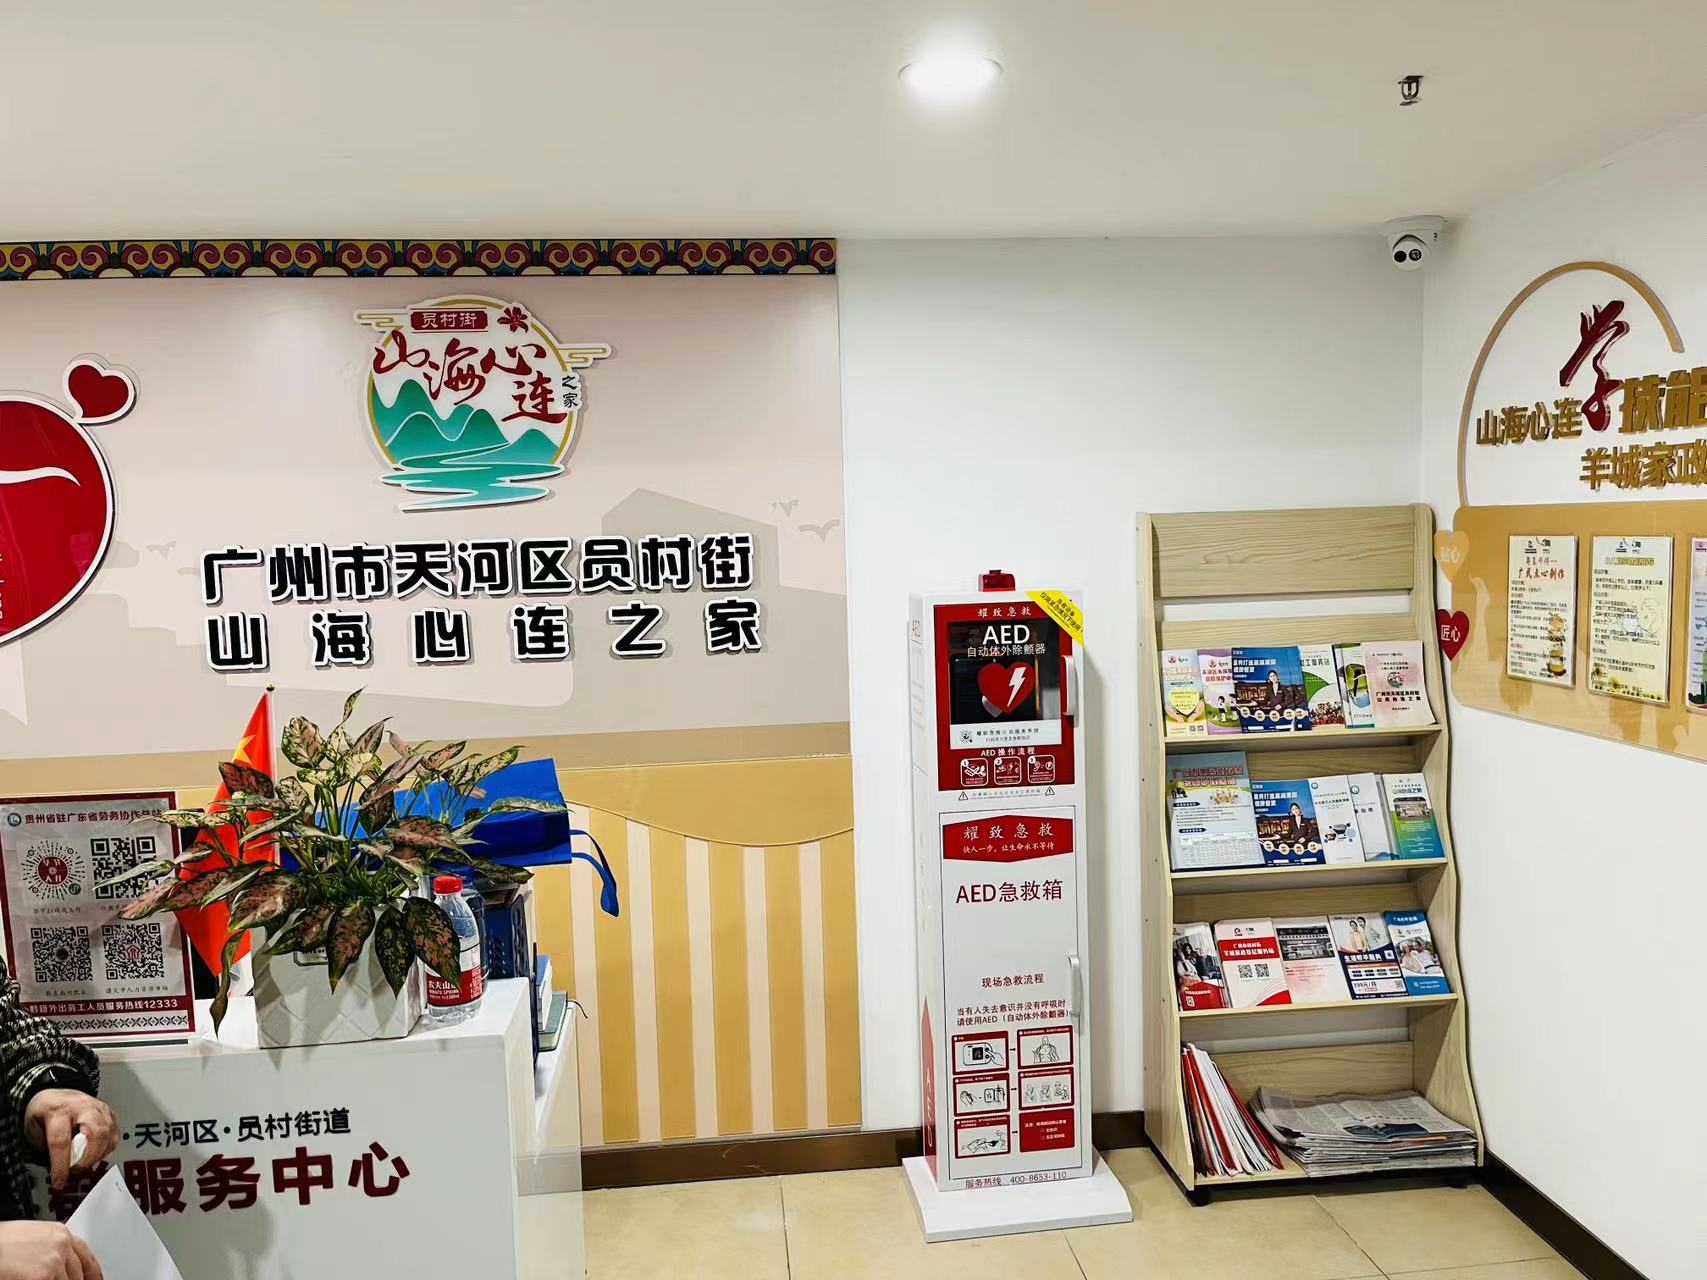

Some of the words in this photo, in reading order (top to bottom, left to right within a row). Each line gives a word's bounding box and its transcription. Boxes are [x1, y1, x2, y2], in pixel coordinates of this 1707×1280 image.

[421, 312, 478, 328] 员村街
[373, 329, 568, 424] 山海心连
[561, 375, 579, 409] 之家
[1476, 397, 1583, 446] 山海心连
[1580, 439, 1707, 491] 羊城家政
[202, 534, 753, 604] 广州市天河区员村街
[977, 606, 1032, 619] 耀致急救
[206, 599, 762, 669] 山海心连之家
[982, 624, 1031, 645] AED
[1440, 624, 1461, 643] 匠心
[967, 643, 1046, 658] 自动体外除颤器
[980, 749, 996, 757] AED
[963, 822, 1055, 840] 耀致急救
[955, 879, 1063, 904] AED急救箱
[981, 973, 1045, 989] 现场急救流程
[956, 999, 1066, 1016] 当有人失去意识并没有呼吸时
[964, 1176, 1002, 1189] 服务热线
[1009, 1171, 1068, 1184] 400-8653-110
